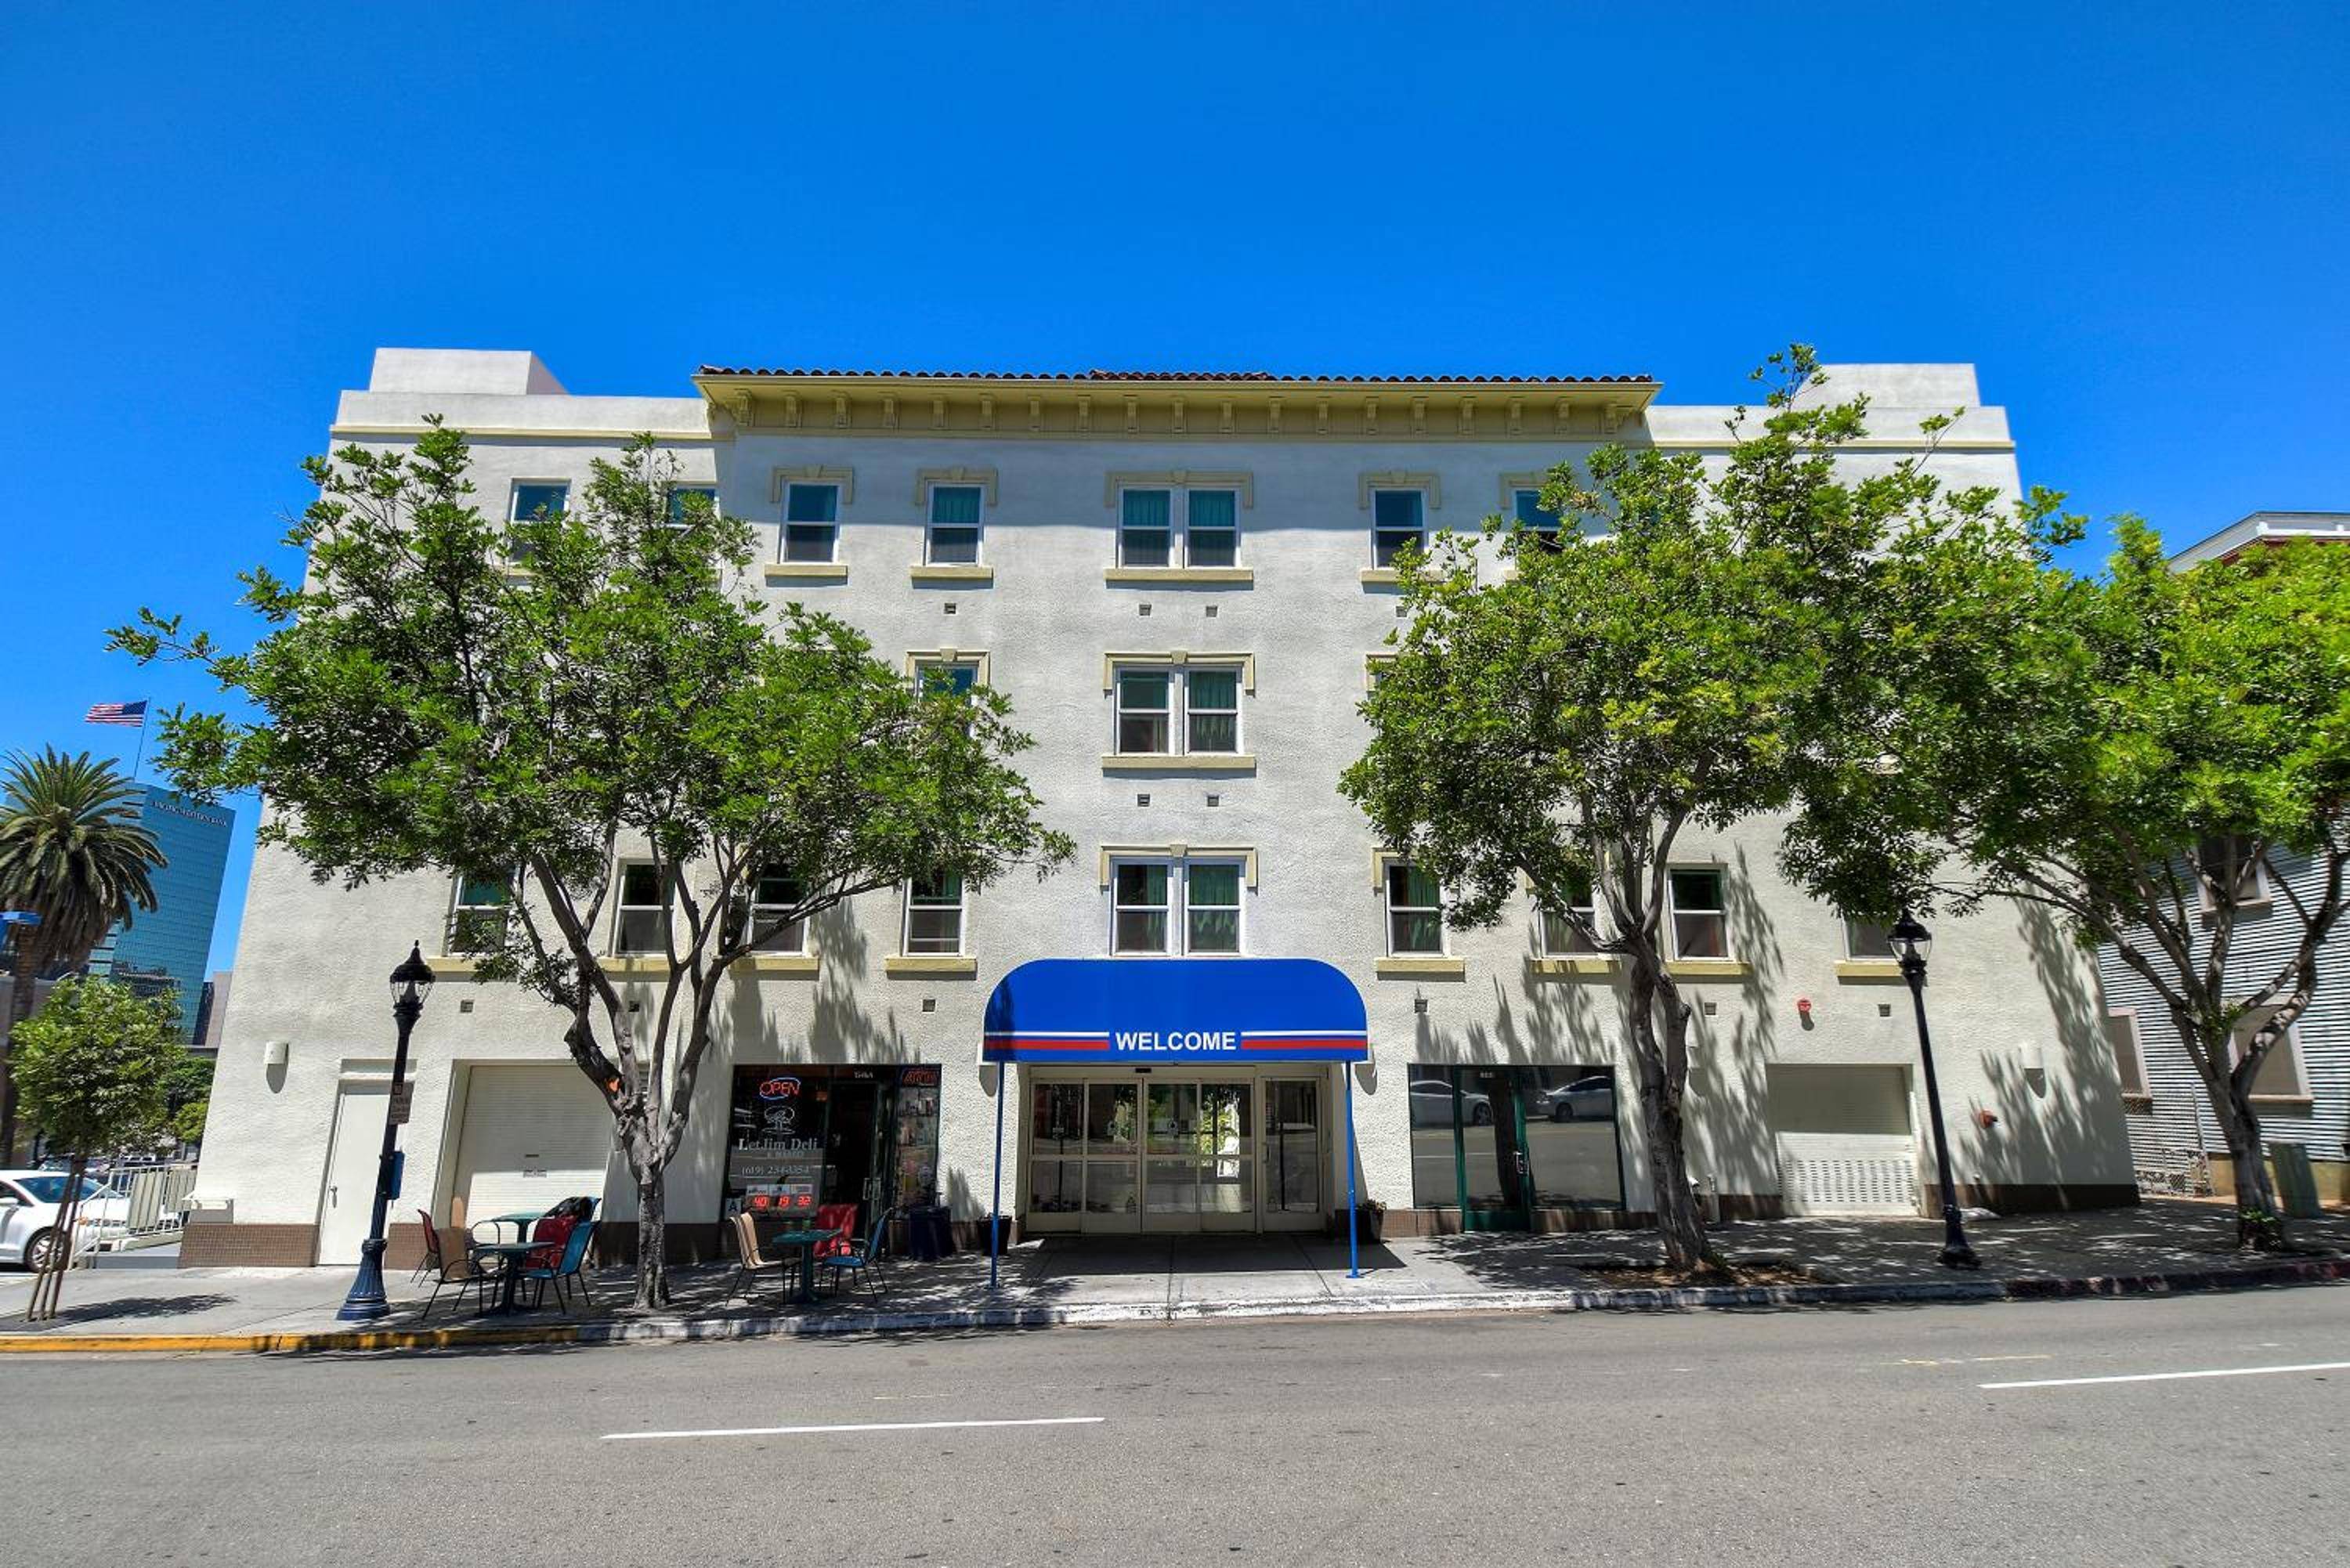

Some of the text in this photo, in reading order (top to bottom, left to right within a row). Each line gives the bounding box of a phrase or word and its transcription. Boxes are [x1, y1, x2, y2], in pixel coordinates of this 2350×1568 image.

[1115, 1031, 1237, 1051] WELCOME
[759, 1082, 799, 1096] OPEN
[790, 1137, 818, 1151] Deli
